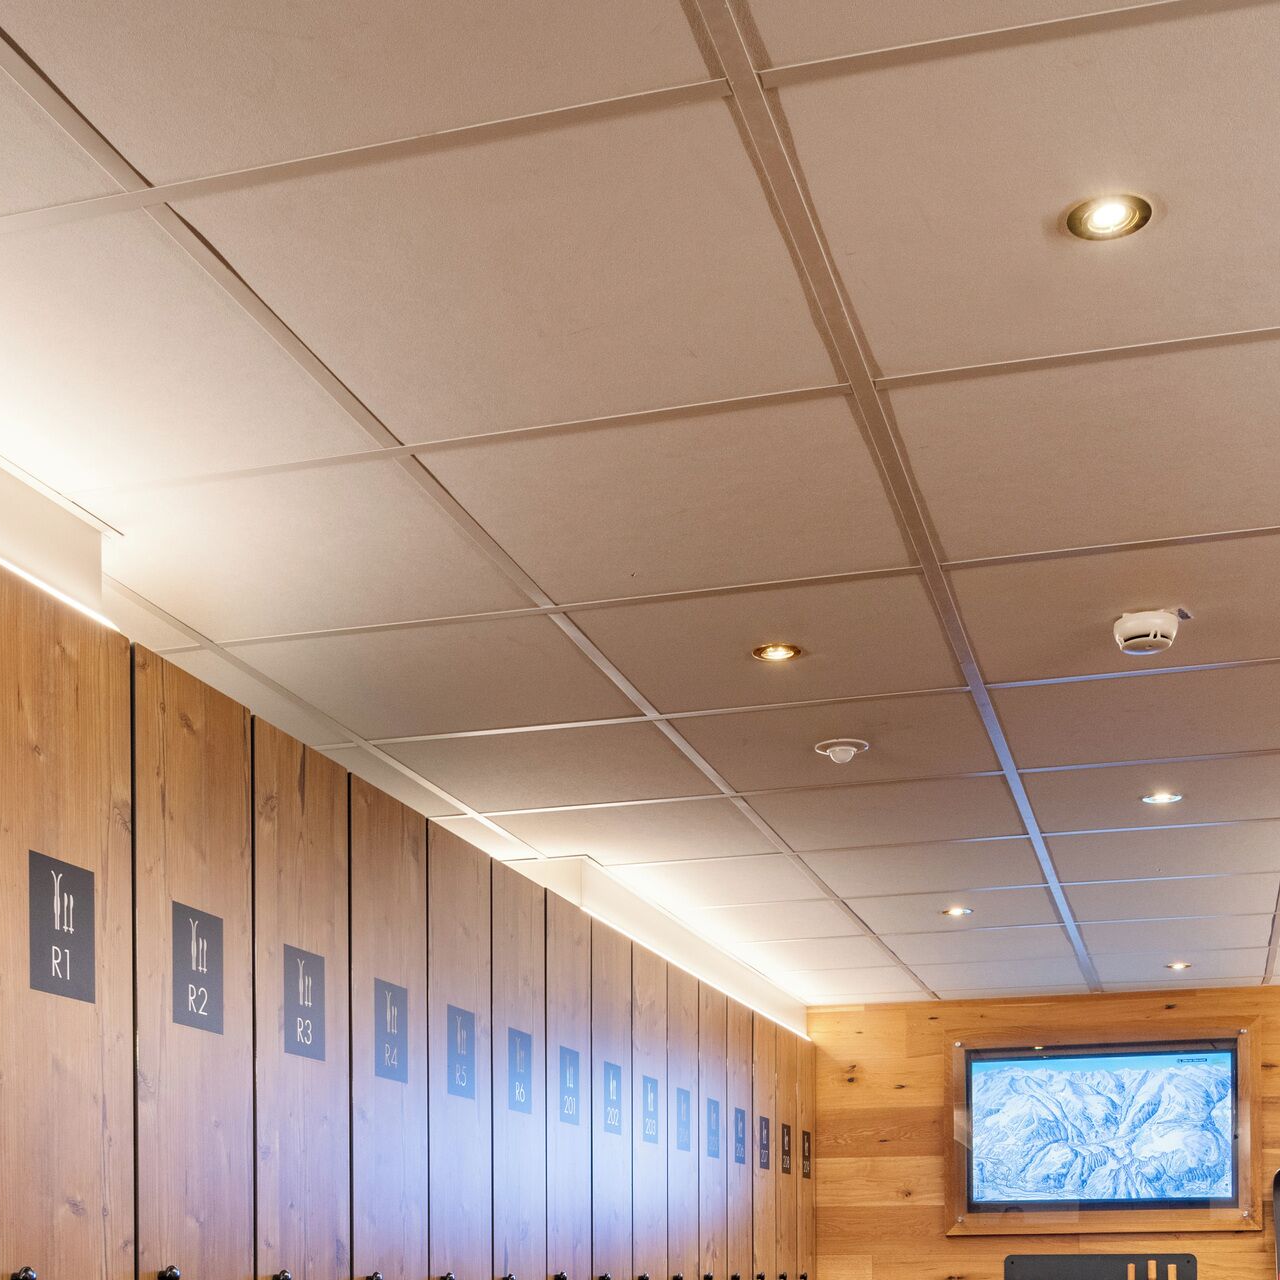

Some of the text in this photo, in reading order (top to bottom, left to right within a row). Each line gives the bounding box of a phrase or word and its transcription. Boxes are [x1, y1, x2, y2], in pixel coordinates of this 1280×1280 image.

[51, 945, 71, 981] R1
[188, 983, 208, 1016] R2
[297, 1017, 313, 1045] R3
[384, 1043, 398, 1068] R4
[455, 1065, 467, 1087] R5
[515, 1081, 526, 1103] R6
[563, 1095, 576, 1116] 201
[607, 1106, 619, 1126] 202
[645, 1118, 656, 1136] 203
